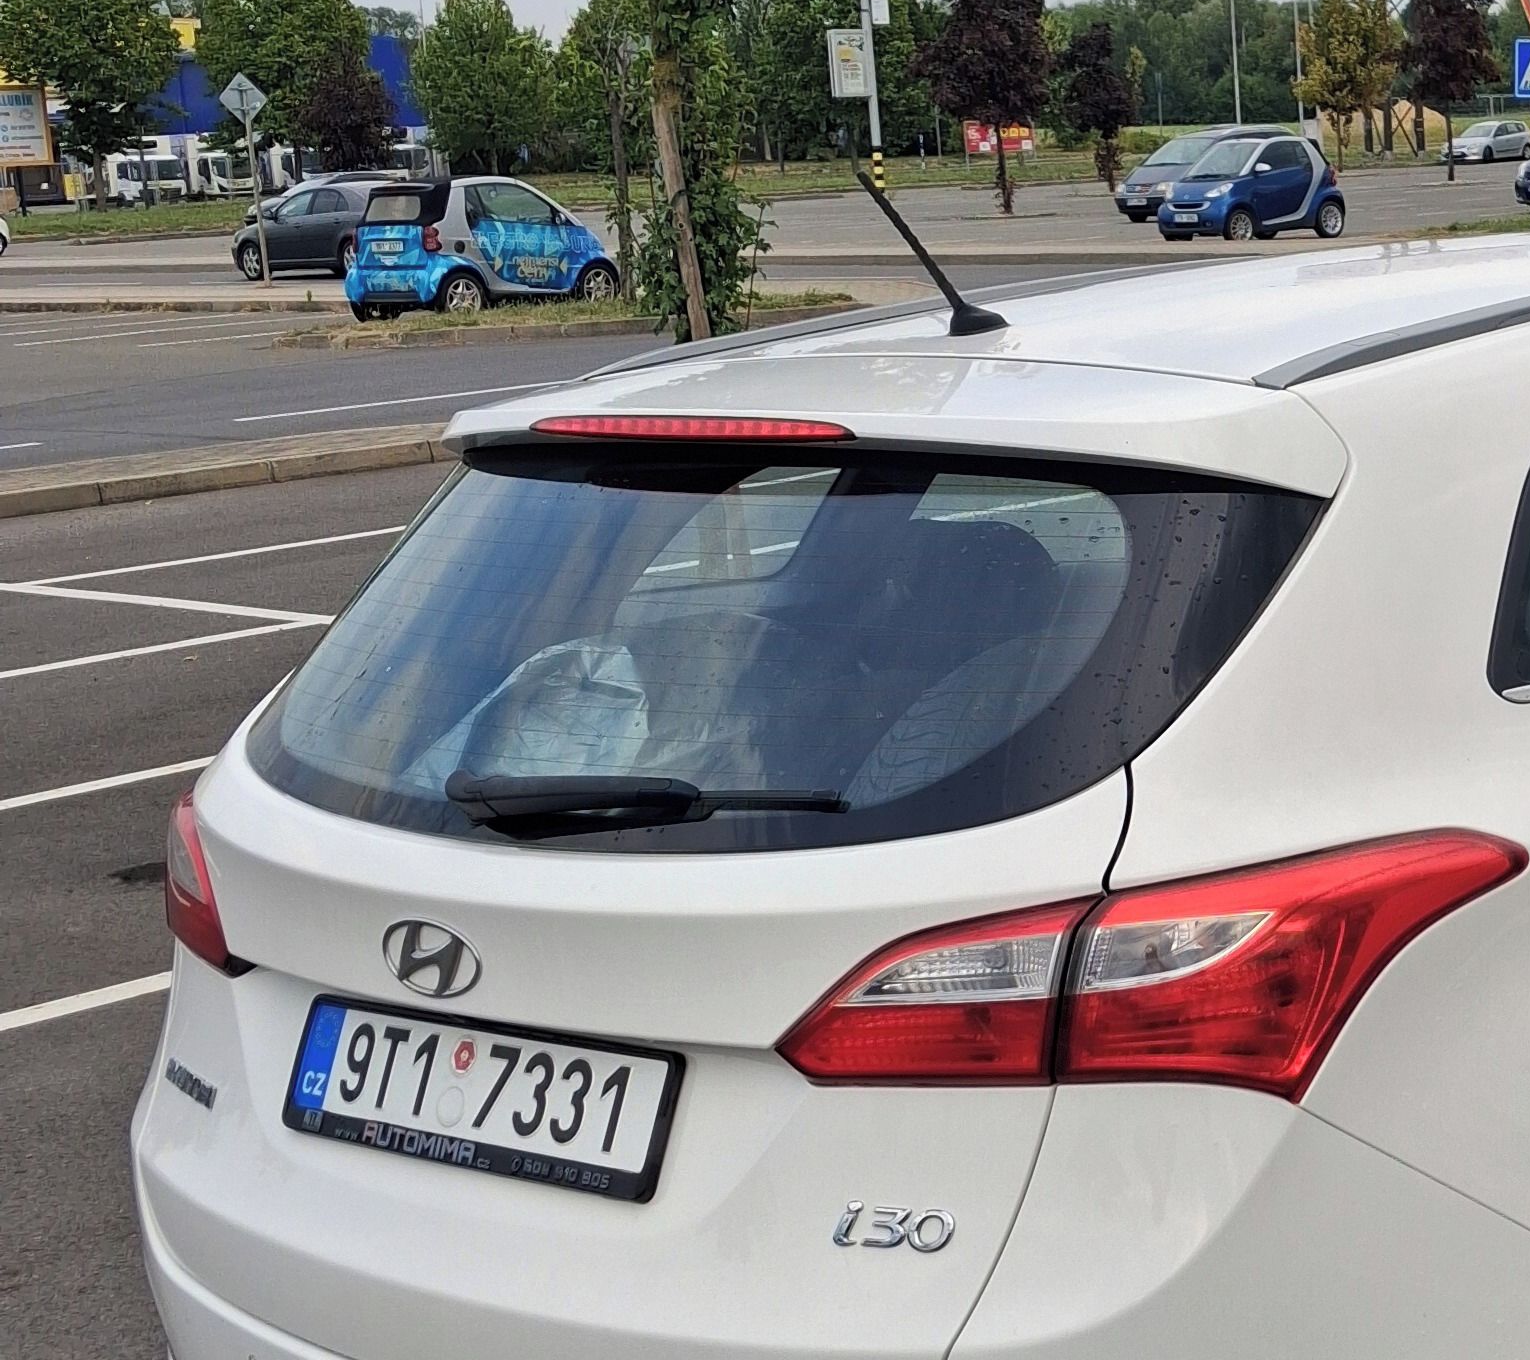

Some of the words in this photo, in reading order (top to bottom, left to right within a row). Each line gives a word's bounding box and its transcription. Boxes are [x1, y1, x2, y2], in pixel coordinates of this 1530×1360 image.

[302, 1070, 327, 1096] CZ
[340, 1022, 441, 1116] 9T1
[471, 1044, 634, 1152] 7331
[833, 1200, 956, 1253] i30
